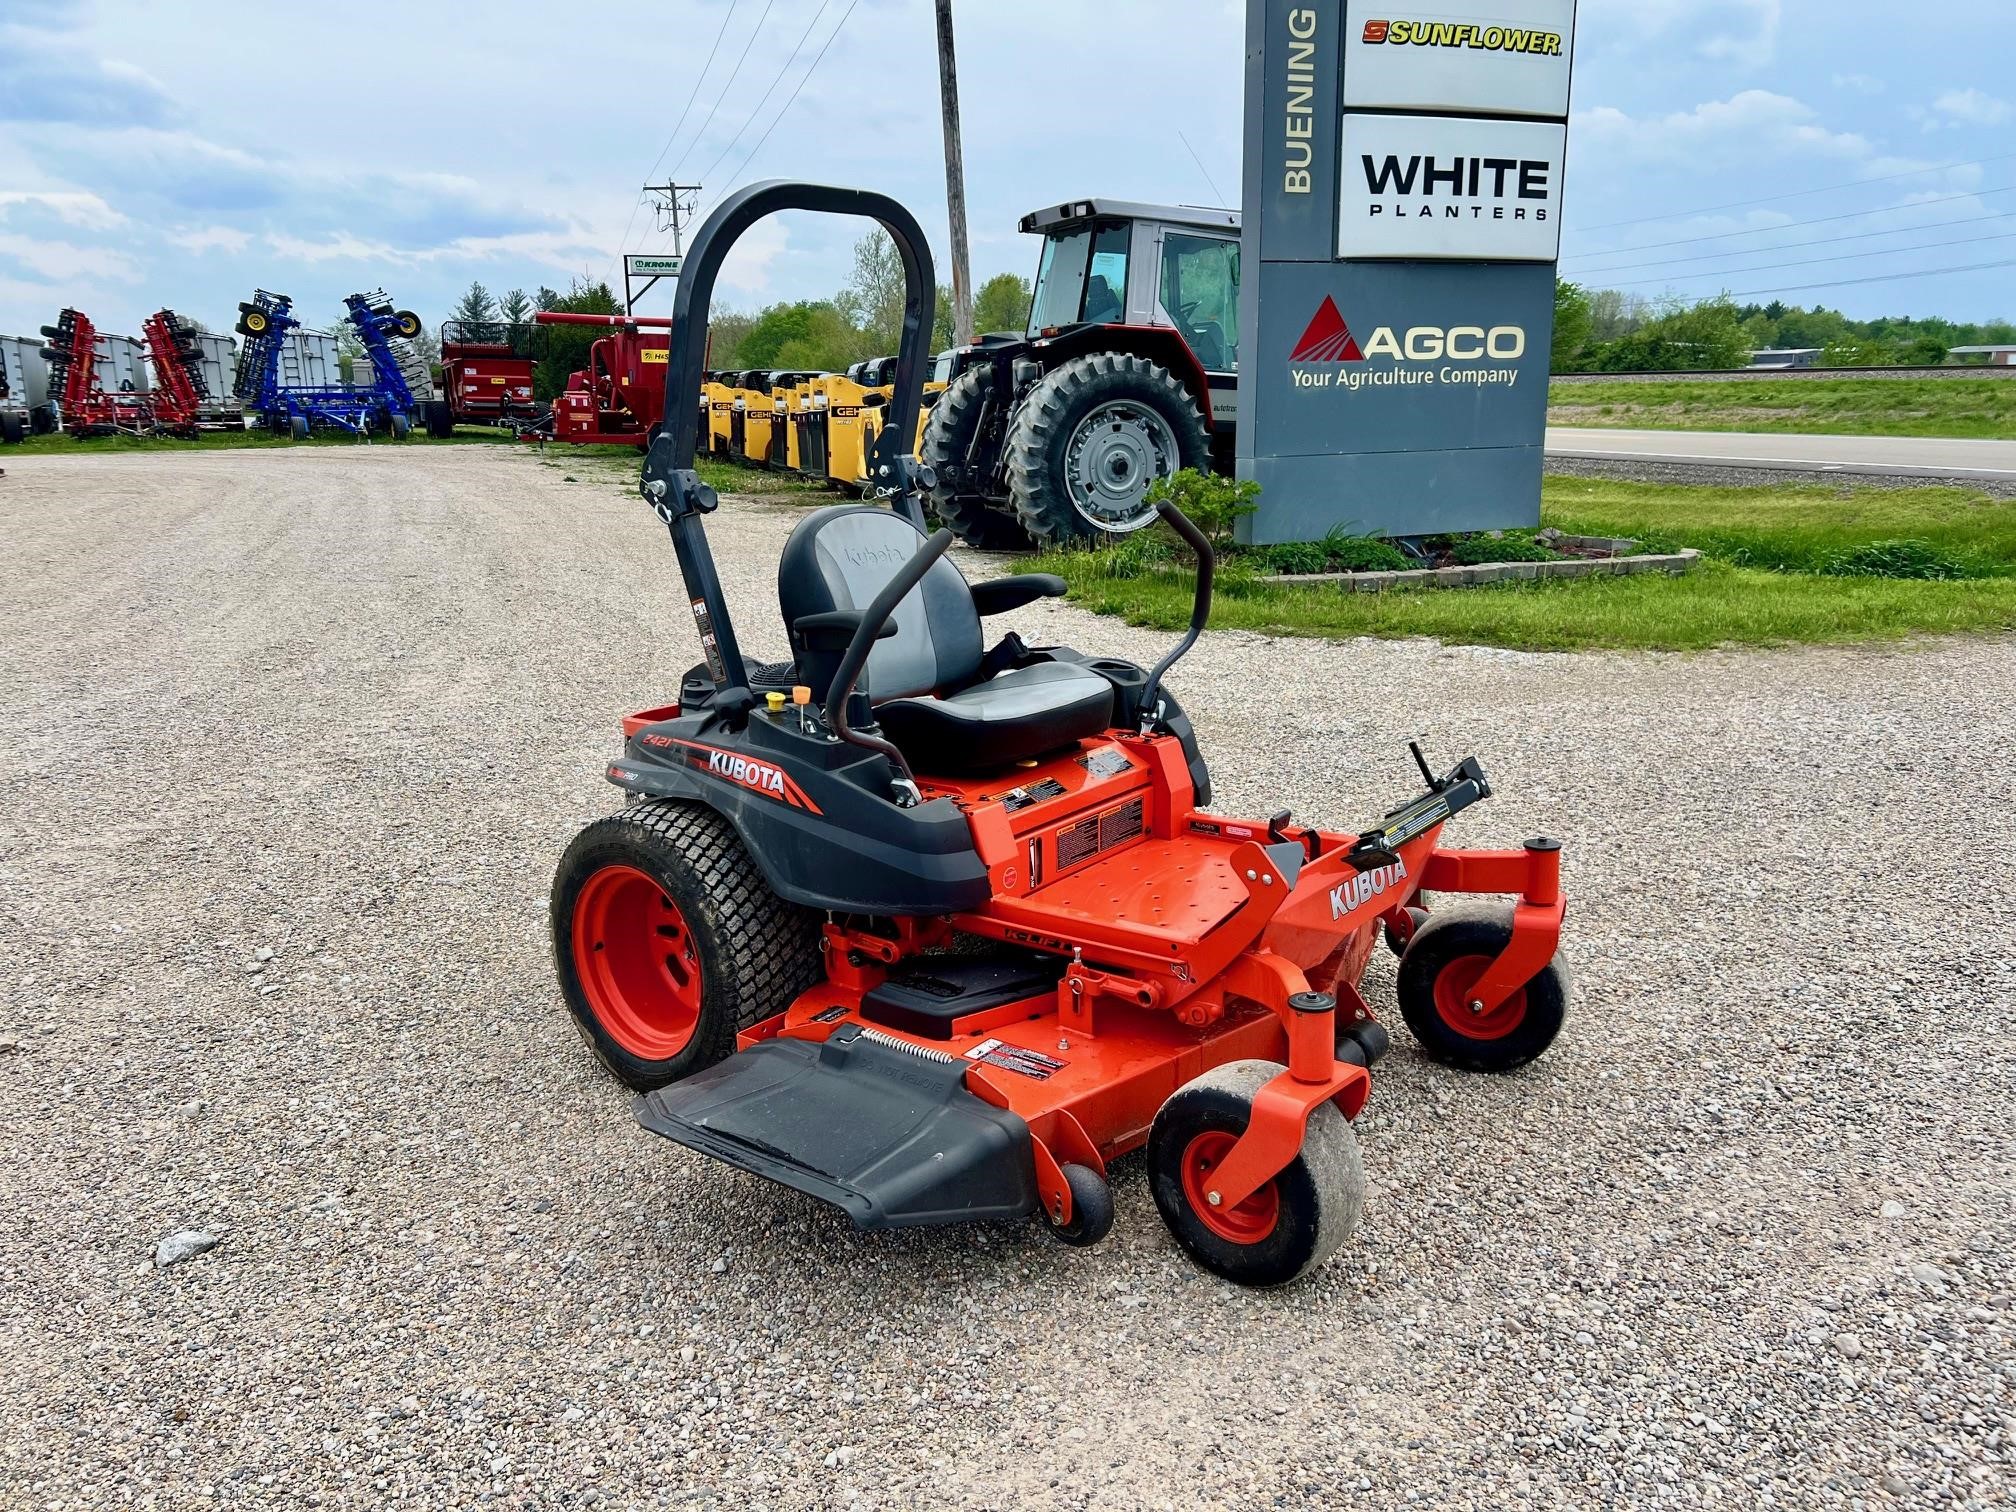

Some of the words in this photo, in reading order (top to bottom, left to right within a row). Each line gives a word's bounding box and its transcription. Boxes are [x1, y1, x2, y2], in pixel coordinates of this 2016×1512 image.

[1388, 20, 1561, 56] SUNFLOWER
[1285, 9, 1316, 193] BUENING
[1361, 154, 1550, 200] WHITE
[1369, 204, 1547, 221] PLANTERS
[1363, 326, 1525, 361] AGCO
[1292, 369, 1331, 387] Your
[1336, 367, 1434, 390] Agriculture
[1439, 366, 1518, 388] Company
[836, 407, 861, 416] GEH
[709, 750, 785, 794] KUBOTA
[1329, 852, 1408, 921] KUBOTA
